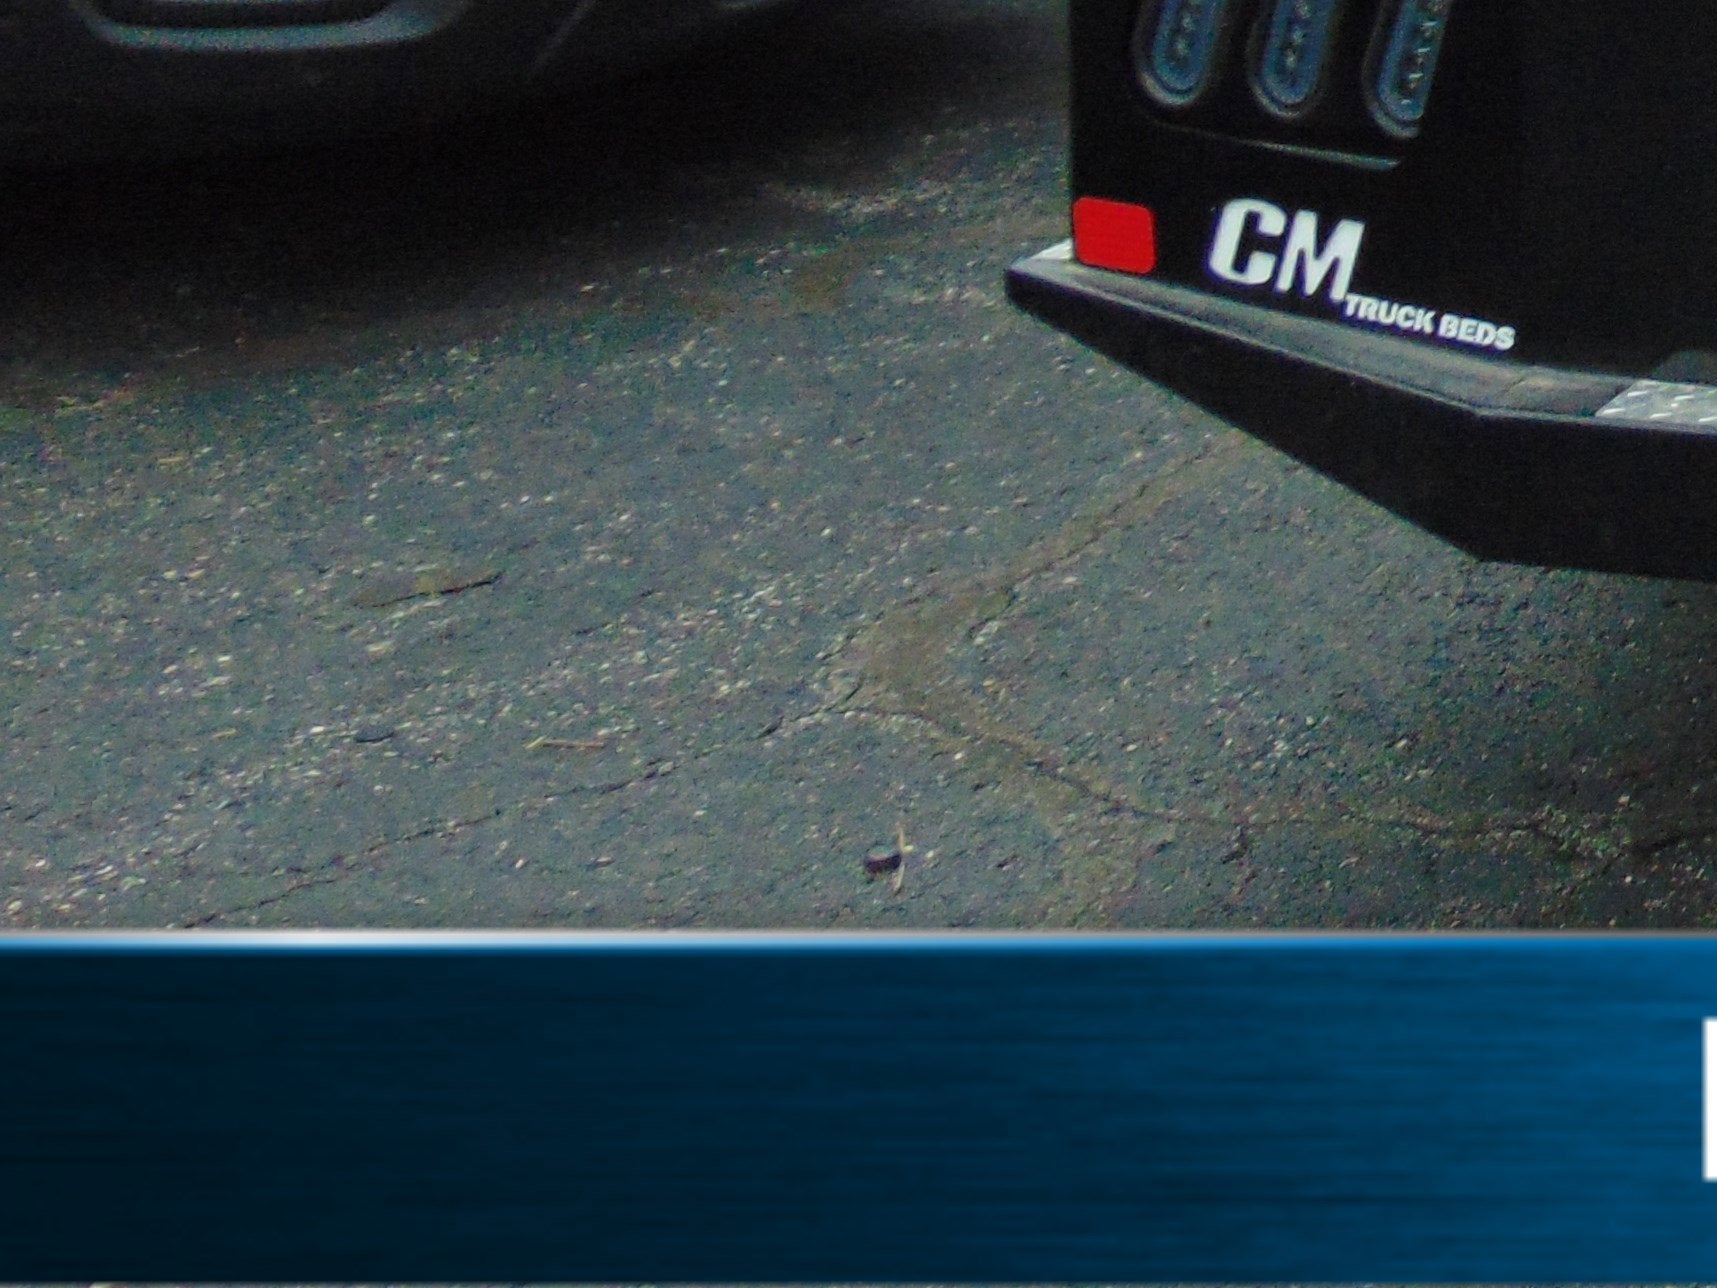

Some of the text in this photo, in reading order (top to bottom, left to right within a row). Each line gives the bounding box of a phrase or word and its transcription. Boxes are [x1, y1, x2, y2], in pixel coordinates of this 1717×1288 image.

[1208, 198, 1366, 303] CM
[1343, 293, 1516, 351] TRUCK BEDS
